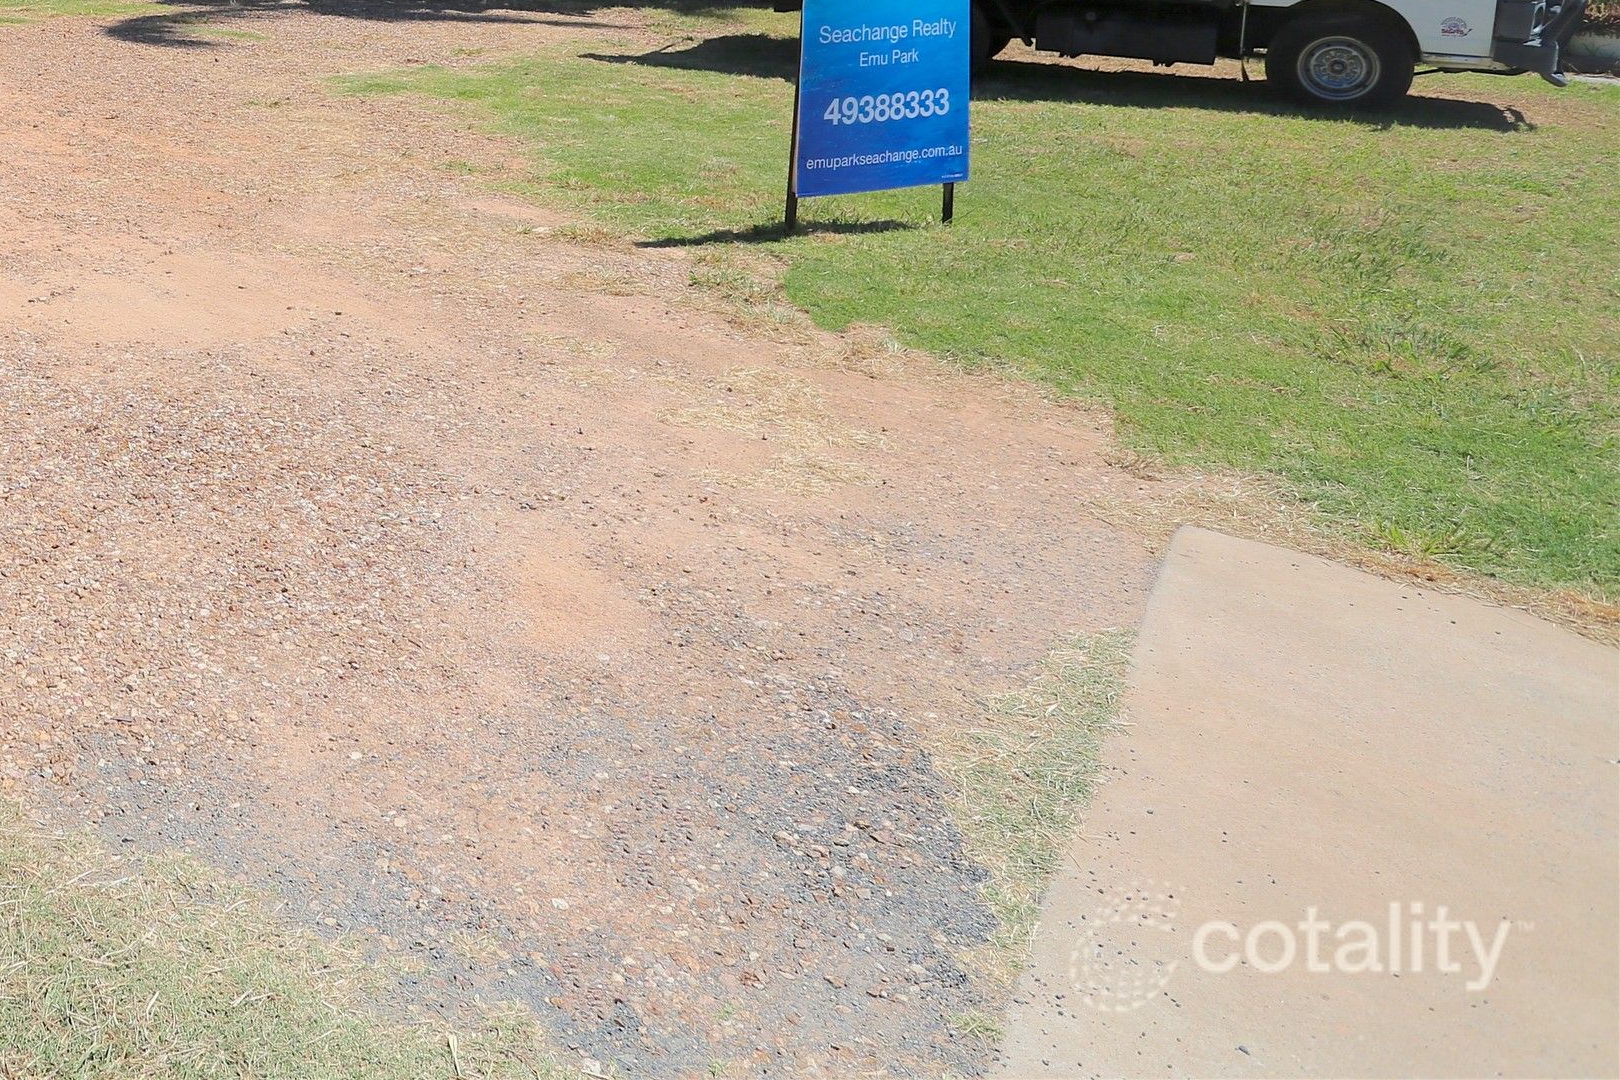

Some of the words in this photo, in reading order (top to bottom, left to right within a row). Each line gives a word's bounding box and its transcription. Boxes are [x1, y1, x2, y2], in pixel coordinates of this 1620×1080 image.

[819, 22, 908, 44] Seachange
[912, 18, 957, 39] Realty
[859, 51, 888, 67] Emu
[892, 48, 919, 65] Park
[824, 88, 950, 125] 49388333
[806, 144, 963, 170] emuparkseachange.com.au
